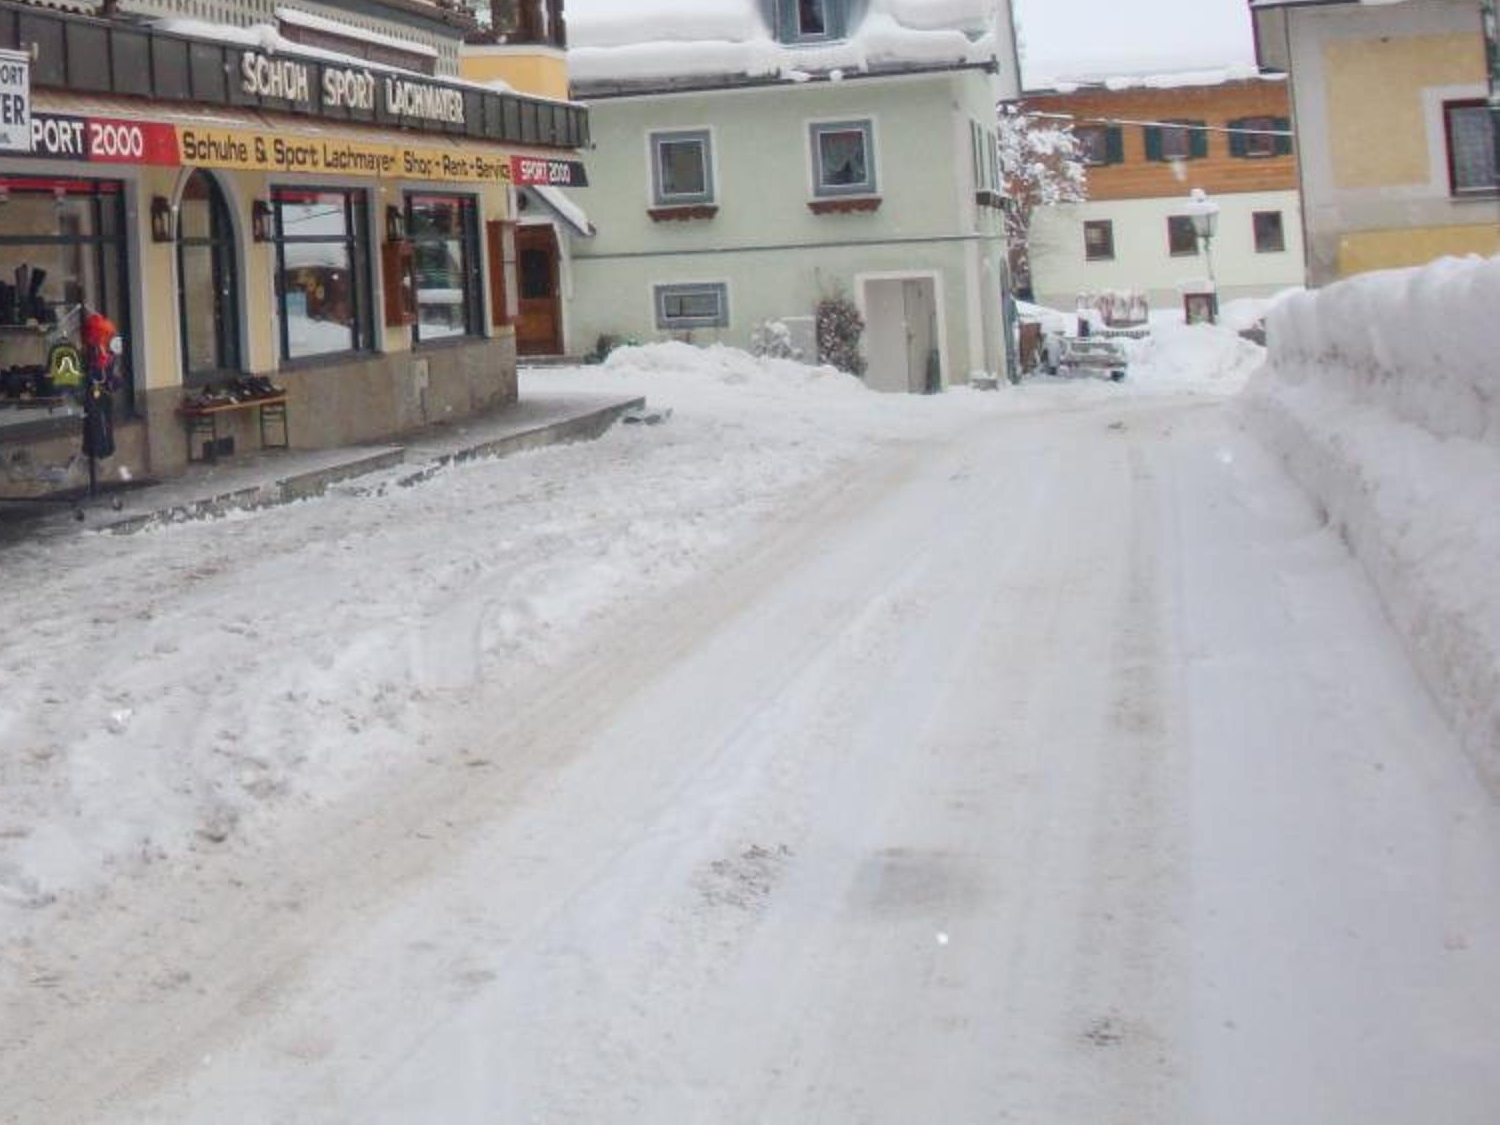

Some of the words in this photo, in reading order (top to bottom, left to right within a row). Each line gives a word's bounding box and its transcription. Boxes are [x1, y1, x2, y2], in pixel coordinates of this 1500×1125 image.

[242, 52, 309, 102] SCHUH
[323, 67, 376, 110] SPORT
[385, 76, 465, 124] LACHMAYER
[31, 118, 84, 153] PORT
[90, 122, 143, 157] 2000
[182, 130, 248, 161] Schuhe
[255, 136, 268, 163] &
[273, 138, 318, 171] Sport
[323, 143, 395, 172] Lachmayer
[521, 159, 547, 181] SPORT
[548, 162, 571, 184] 2000
